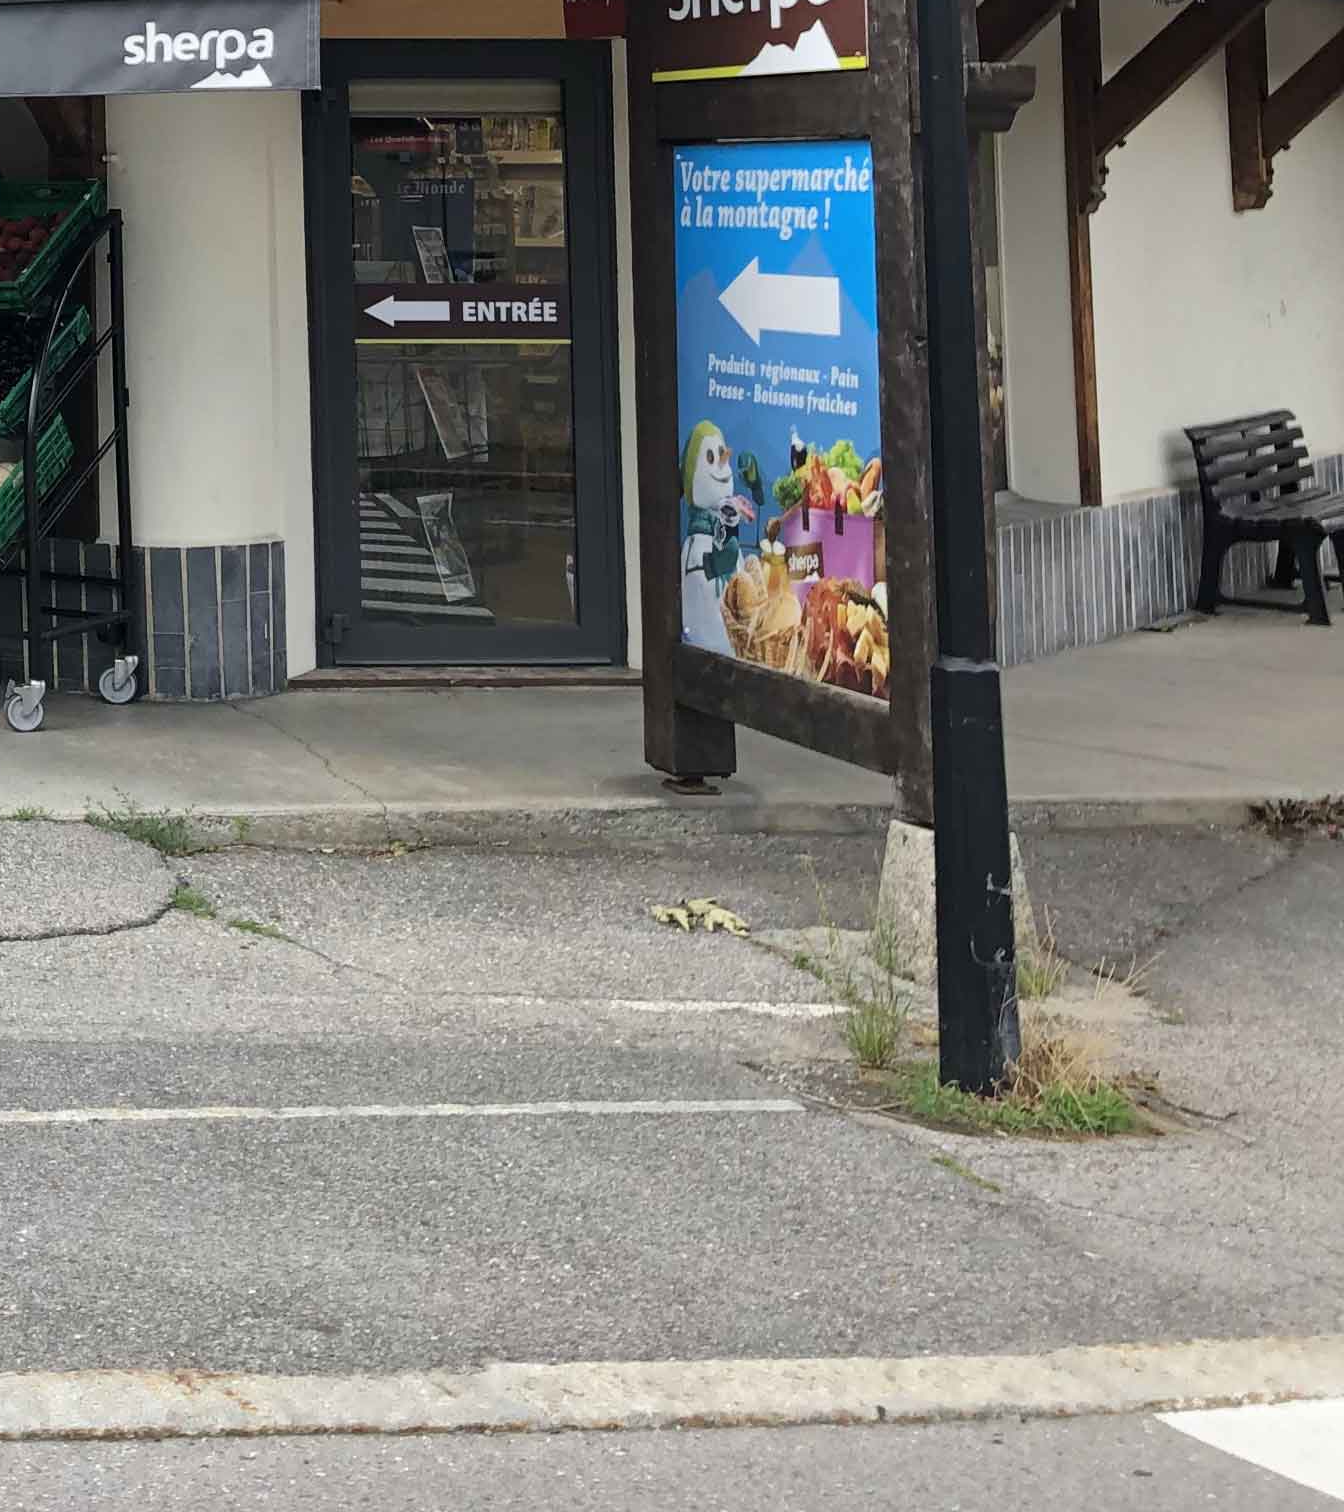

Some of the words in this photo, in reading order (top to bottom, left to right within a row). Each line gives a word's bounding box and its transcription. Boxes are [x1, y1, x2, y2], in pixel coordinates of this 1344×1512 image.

[123, 21, 274, 70] sherpa
[680, 161, 731, 193] Votre
[735, 155, 871, 203] supermarché
[680, 197, 691, 228] à
[696, 194, 714, 228] la
[718, 201, 819, 241] montagne
[462, 297, 558, 323] ENTRÉE
[708, 353, 756, 377] Produits
[760, 360, 821, 386] régionaux
[830, 366, 859, 389] Pain
[708, 377, 745, 401] Presse
[753, 384, 805, 410] Boissons
